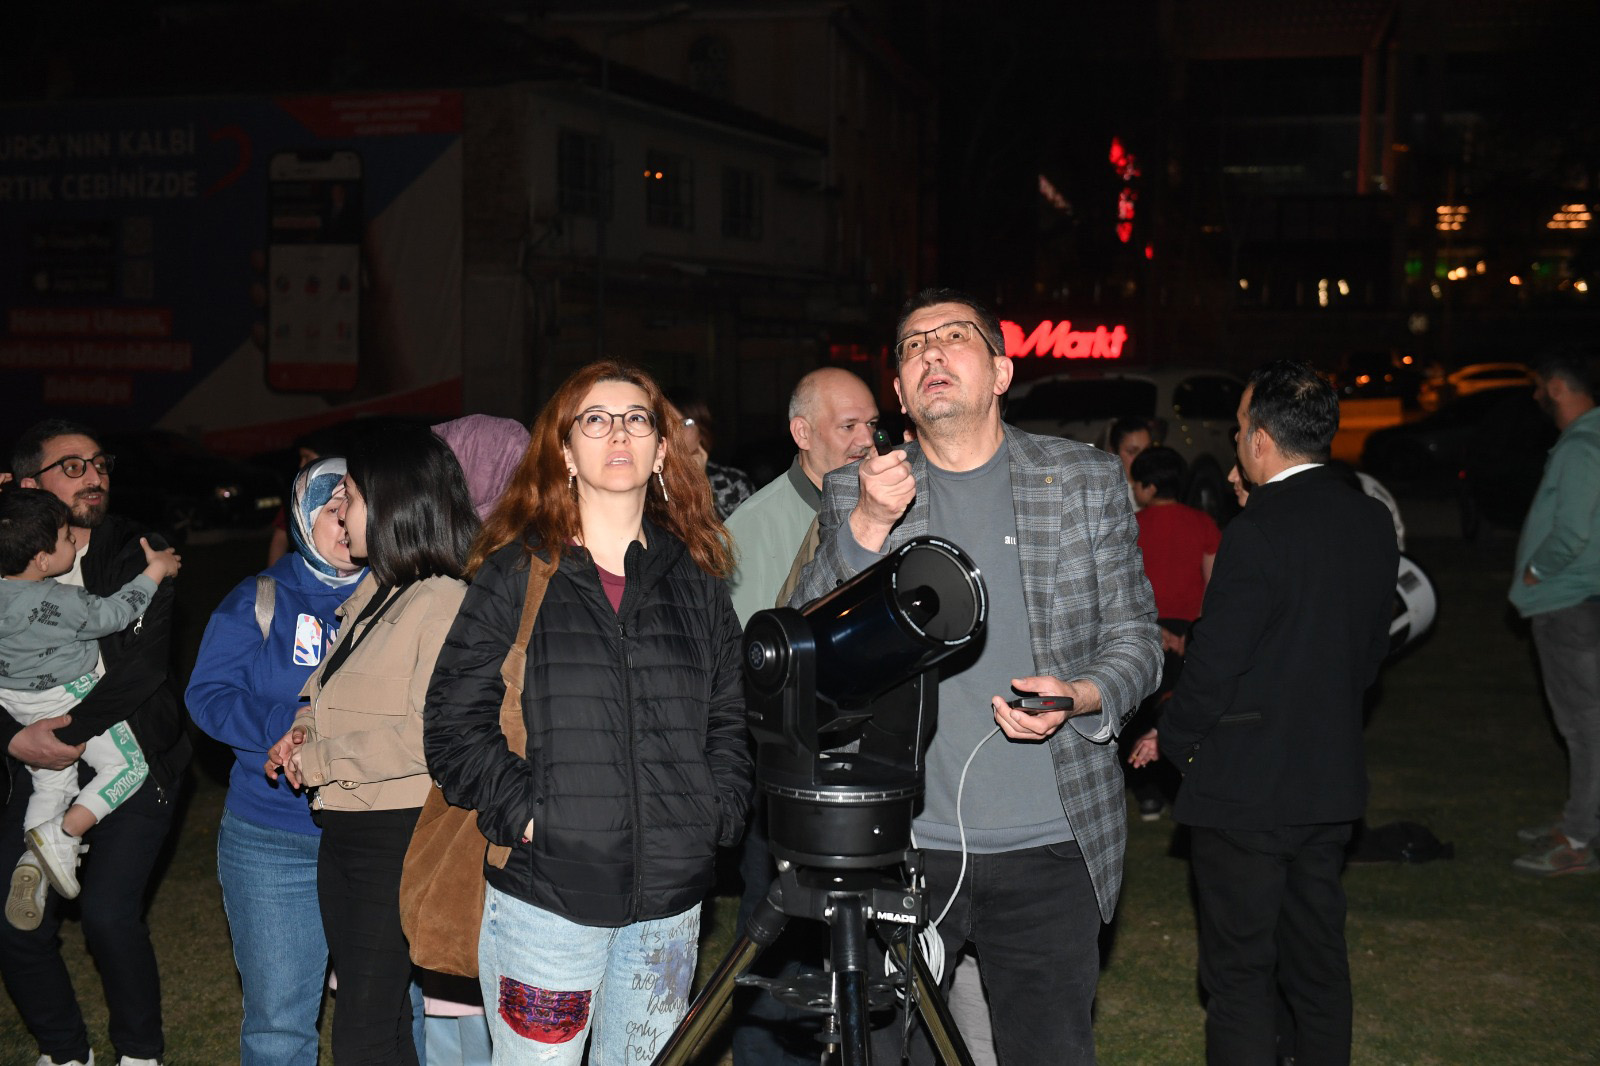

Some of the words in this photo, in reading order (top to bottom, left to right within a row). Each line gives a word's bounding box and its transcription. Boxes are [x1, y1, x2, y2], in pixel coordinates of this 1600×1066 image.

[118, 122, 196, 156] KALBİ
[61, 165, 199, 201] CEBİNİZDE
[877, 911, 917, 924] MEADE
[626, 1020, 667, 1052] only
